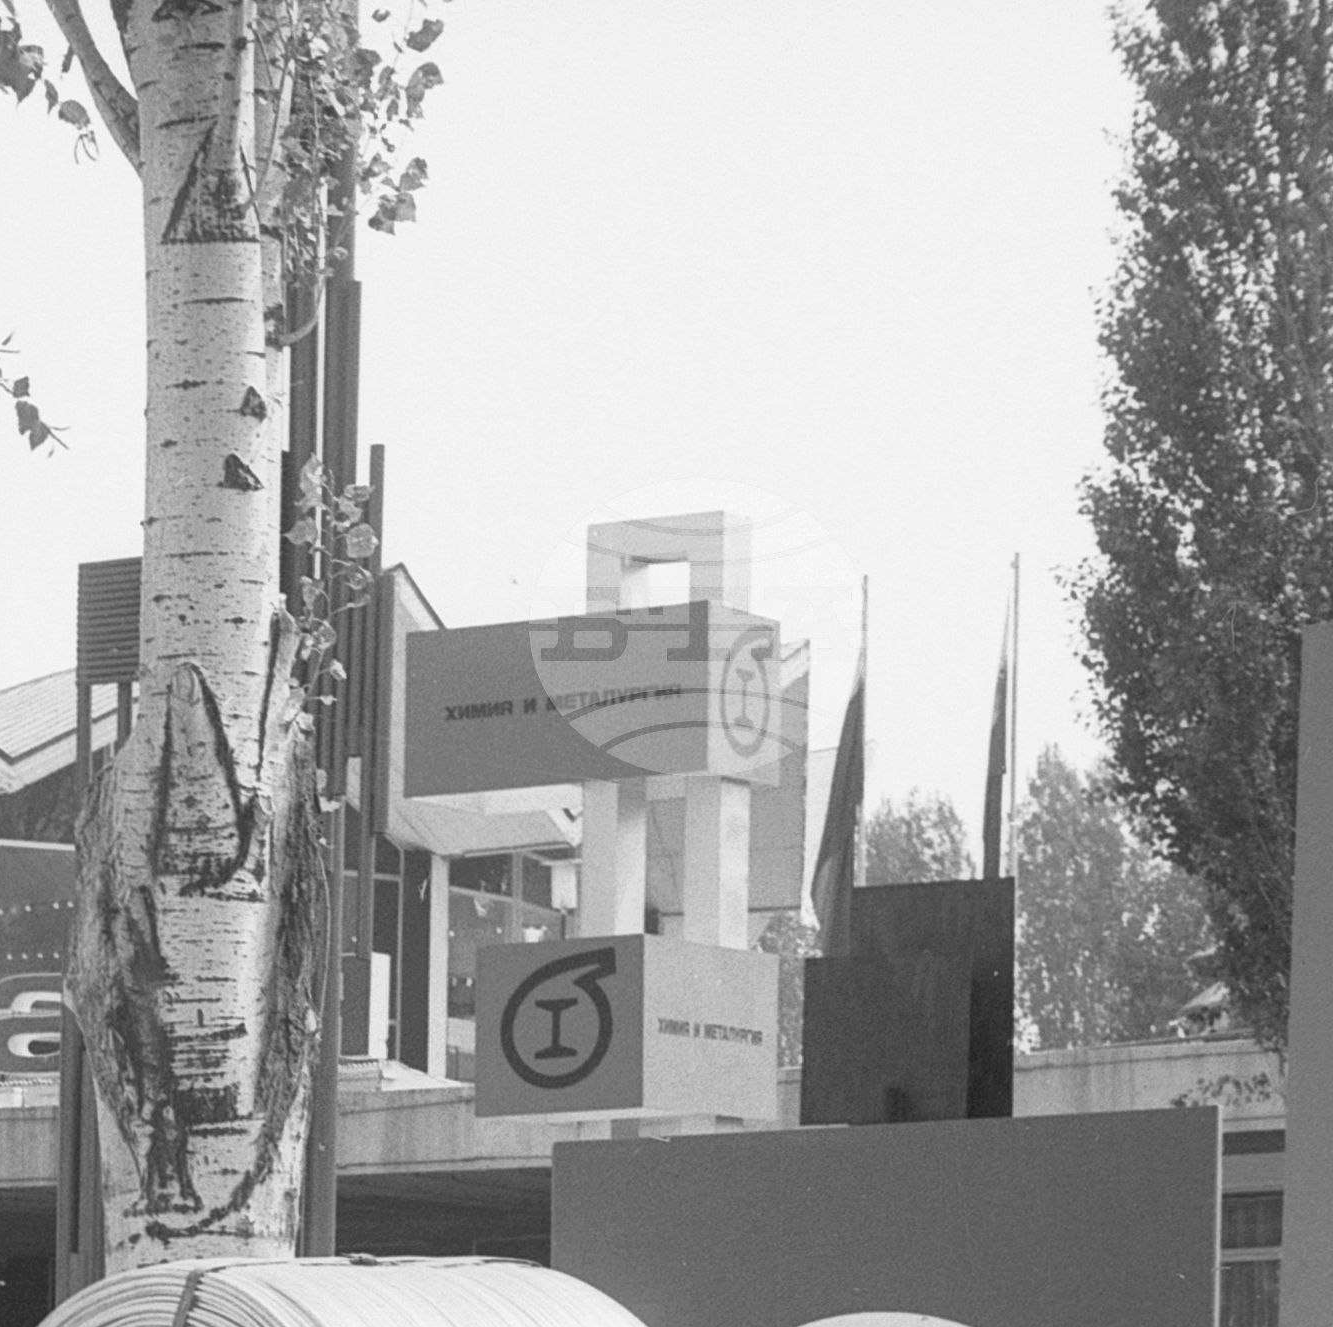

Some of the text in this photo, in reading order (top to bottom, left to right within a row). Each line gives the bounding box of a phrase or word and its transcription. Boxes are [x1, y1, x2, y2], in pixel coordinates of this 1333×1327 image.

[444, 683, 680, 722] ХИМИЯ И МЕТАЛУРГИЯ
